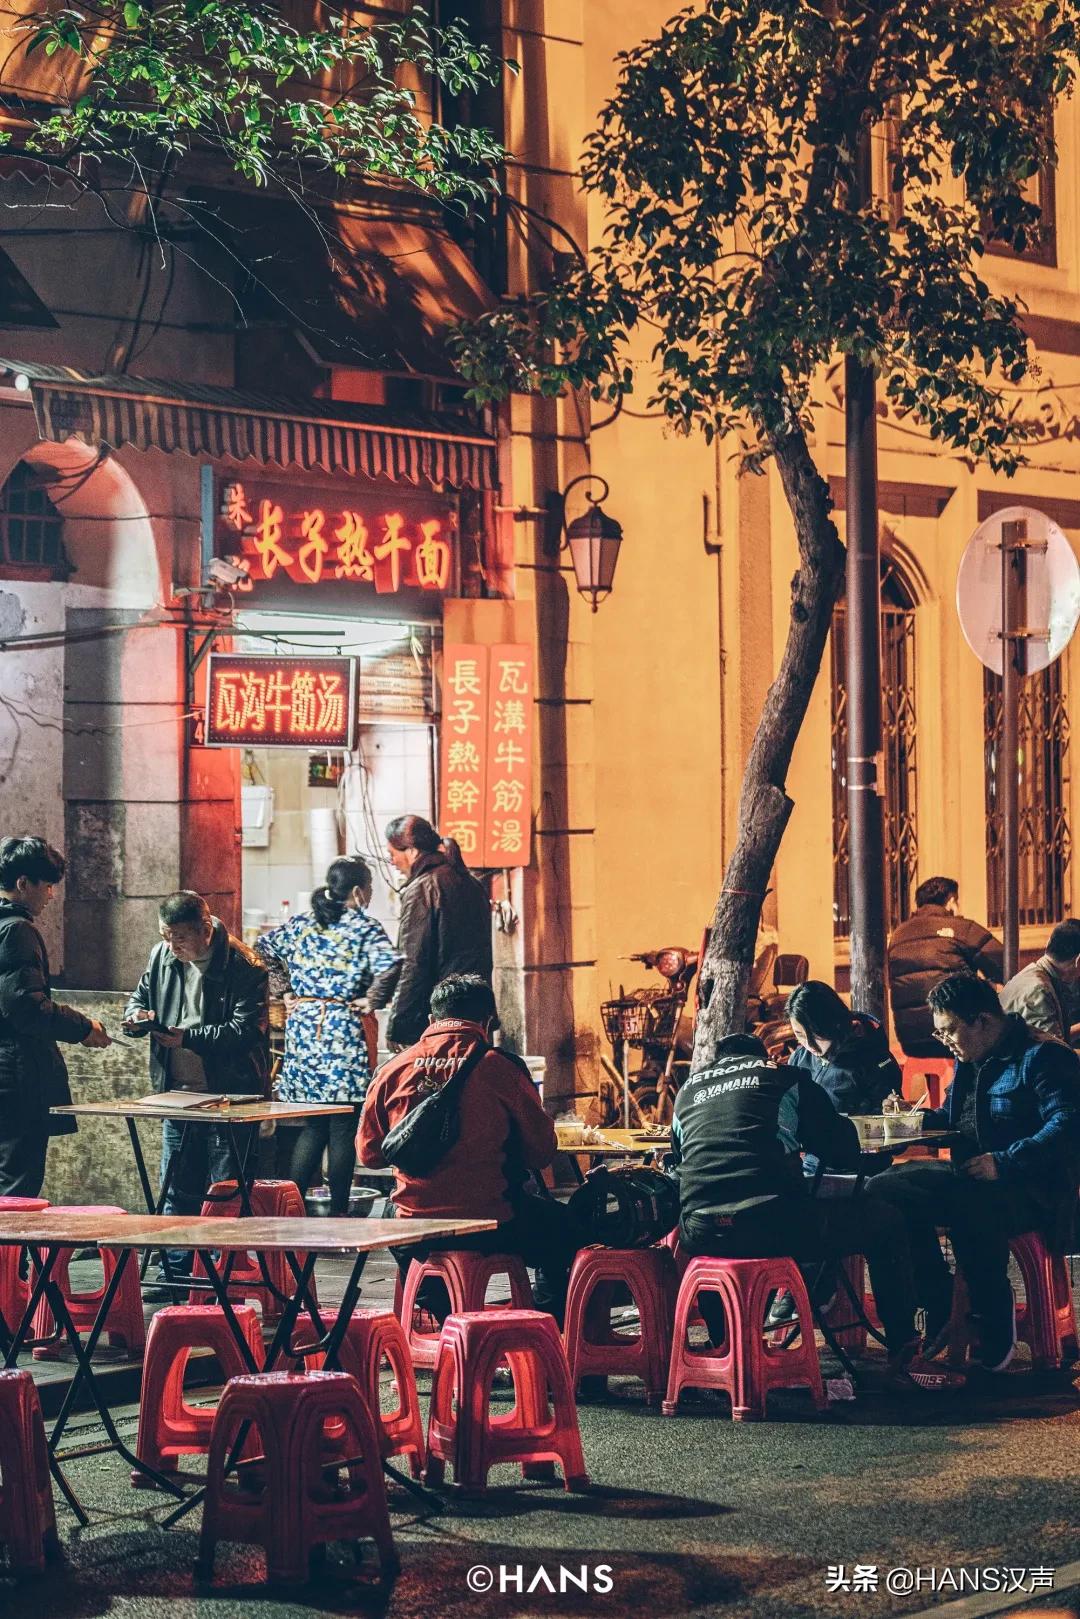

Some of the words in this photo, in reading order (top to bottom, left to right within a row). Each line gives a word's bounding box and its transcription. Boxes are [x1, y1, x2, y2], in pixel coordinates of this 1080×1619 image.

[253, 499, 451, 592] 长子热干面
[215, 671, 344, 732] 瓦沟牛筋汤
[445, 659, 481, 853] 長子熱幹面
[491, 661, 528, 853] 瓦溝牛筋湯
[683, 1059, 778, 1091] PETRONAS
[707, 1076, 760, 1096] YAMAHA
